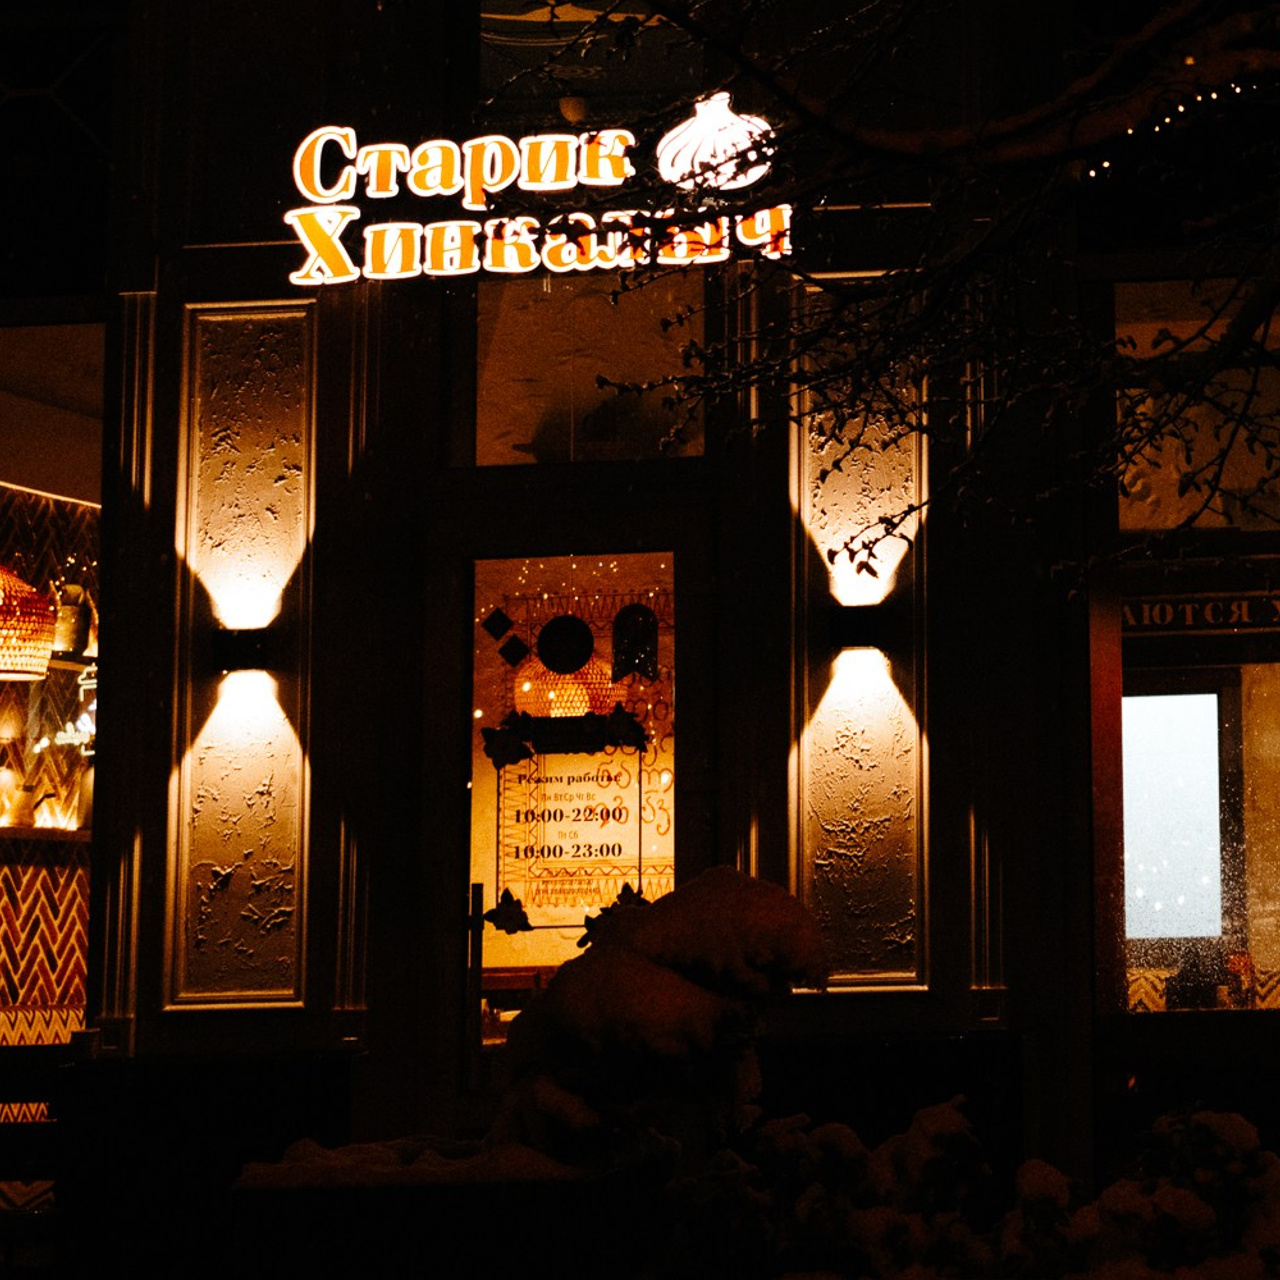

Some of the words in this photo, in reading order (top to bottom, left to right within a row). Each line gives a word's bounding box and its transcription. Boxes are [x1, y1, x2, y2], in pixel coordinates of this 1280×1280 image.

[294, 125, 636, 211] Старик
[515, 807, 623, 823] 10:00-22:00
[514, 843, 622, 859] 10:00-23:00
